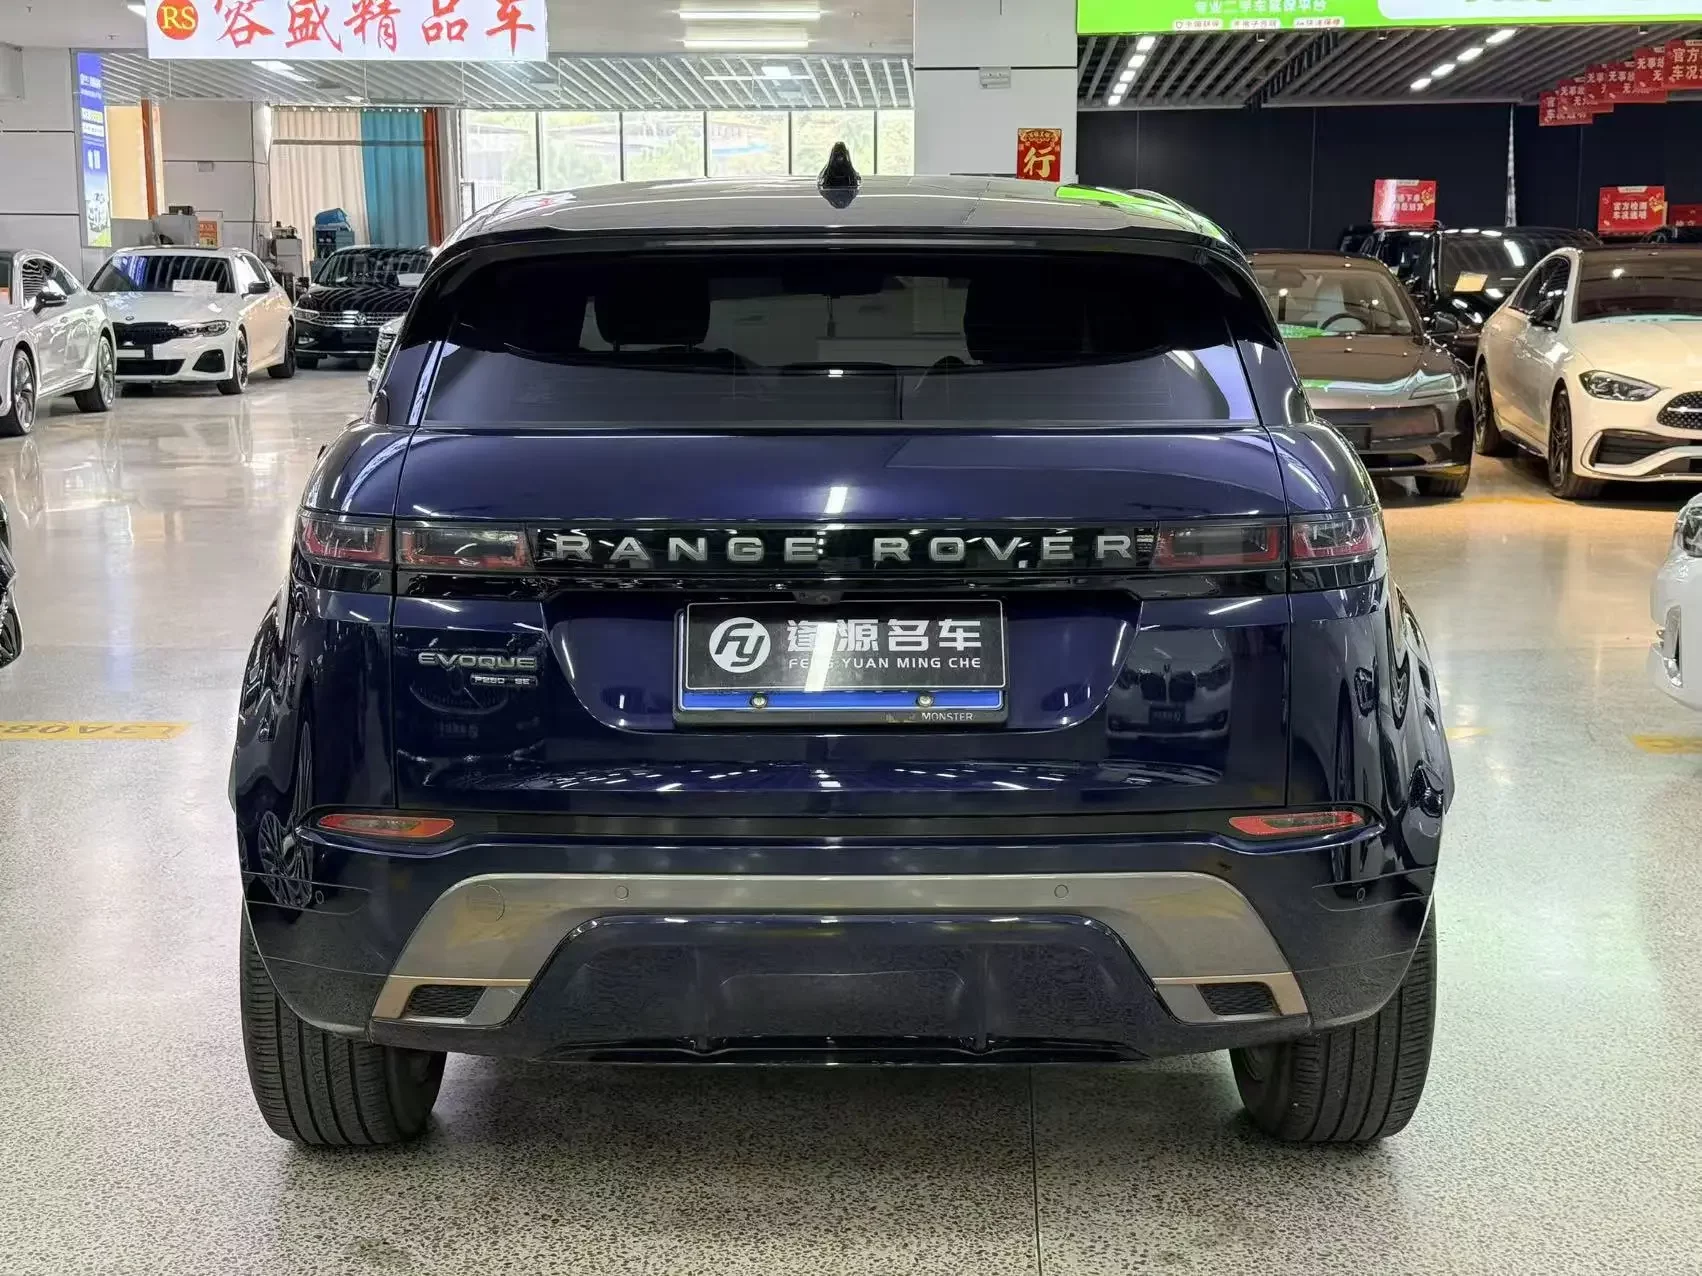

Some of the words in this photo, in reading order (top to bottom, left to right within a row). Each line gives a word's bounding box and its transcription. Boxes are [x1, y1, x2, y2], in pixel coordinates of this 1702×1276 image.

[161, 6, 197, 29] RS
[1673, 47, 1702, 62] 官方
[1672, 65, 1702, 80] 车况
[1024, 147, 1056, 178] 行
[556, 535, 818, 562] RANGE
[873, 535, 1132, 562] ROVER
[418, 652, 537, 669] EVOQUE
[789, 658, 834, 669] FEG
[842, 658, 889, 669] YUAN
[897, 658, 941, 669] MING
[949, 657, 981, 669] CHE
[921, 712, 973, 721] MONSTER
